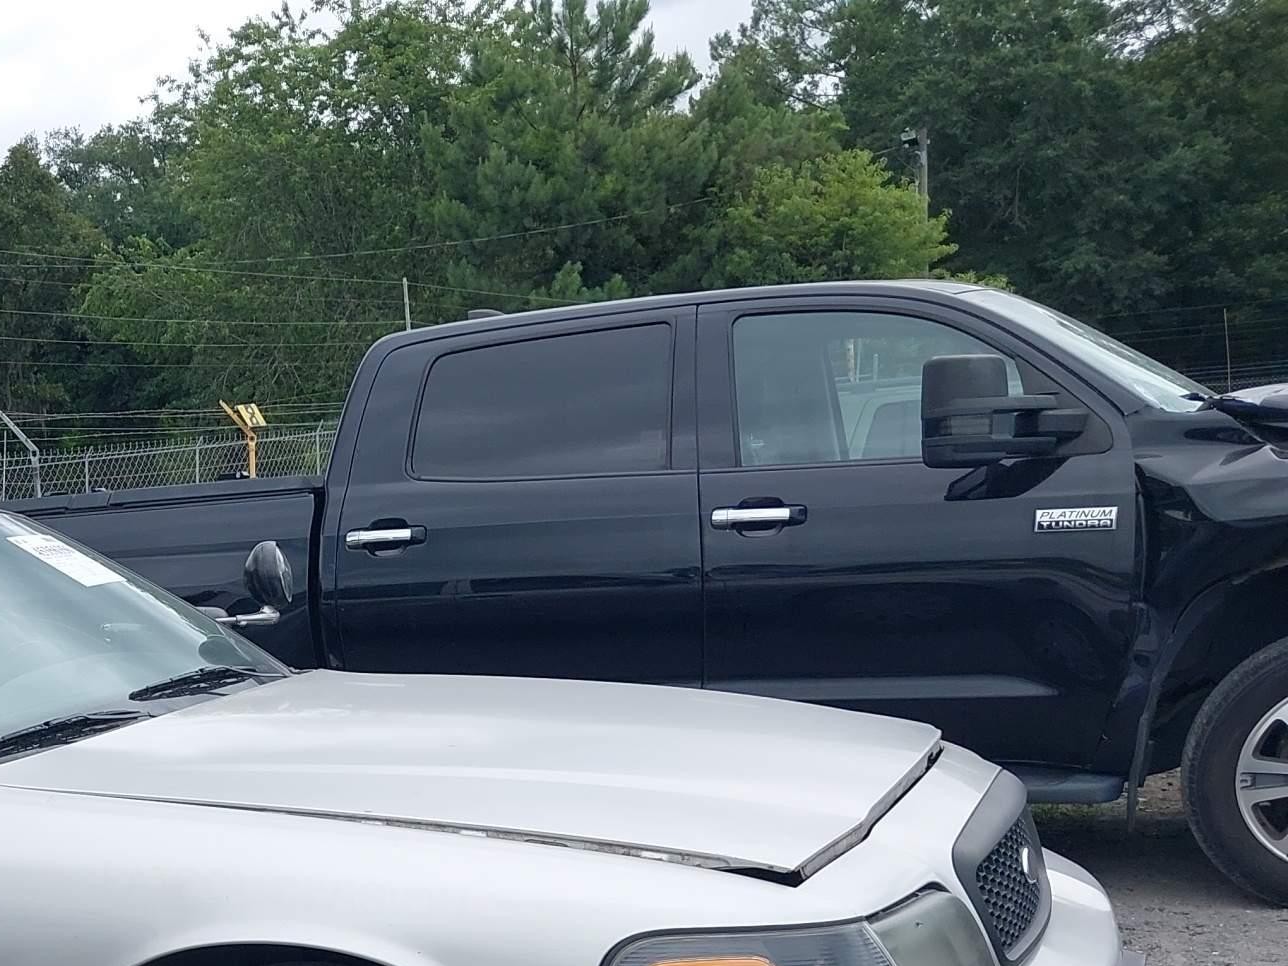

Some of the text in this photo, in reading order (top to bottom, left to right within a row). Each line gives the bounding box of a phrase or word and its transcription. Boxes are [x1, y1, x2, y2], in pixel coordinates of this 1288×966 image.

[243, 404, 261, 425] 8
[1039, 508, 1114, 520] PLATINUM
[1039, 518, 1112, 529] TUNDRA
